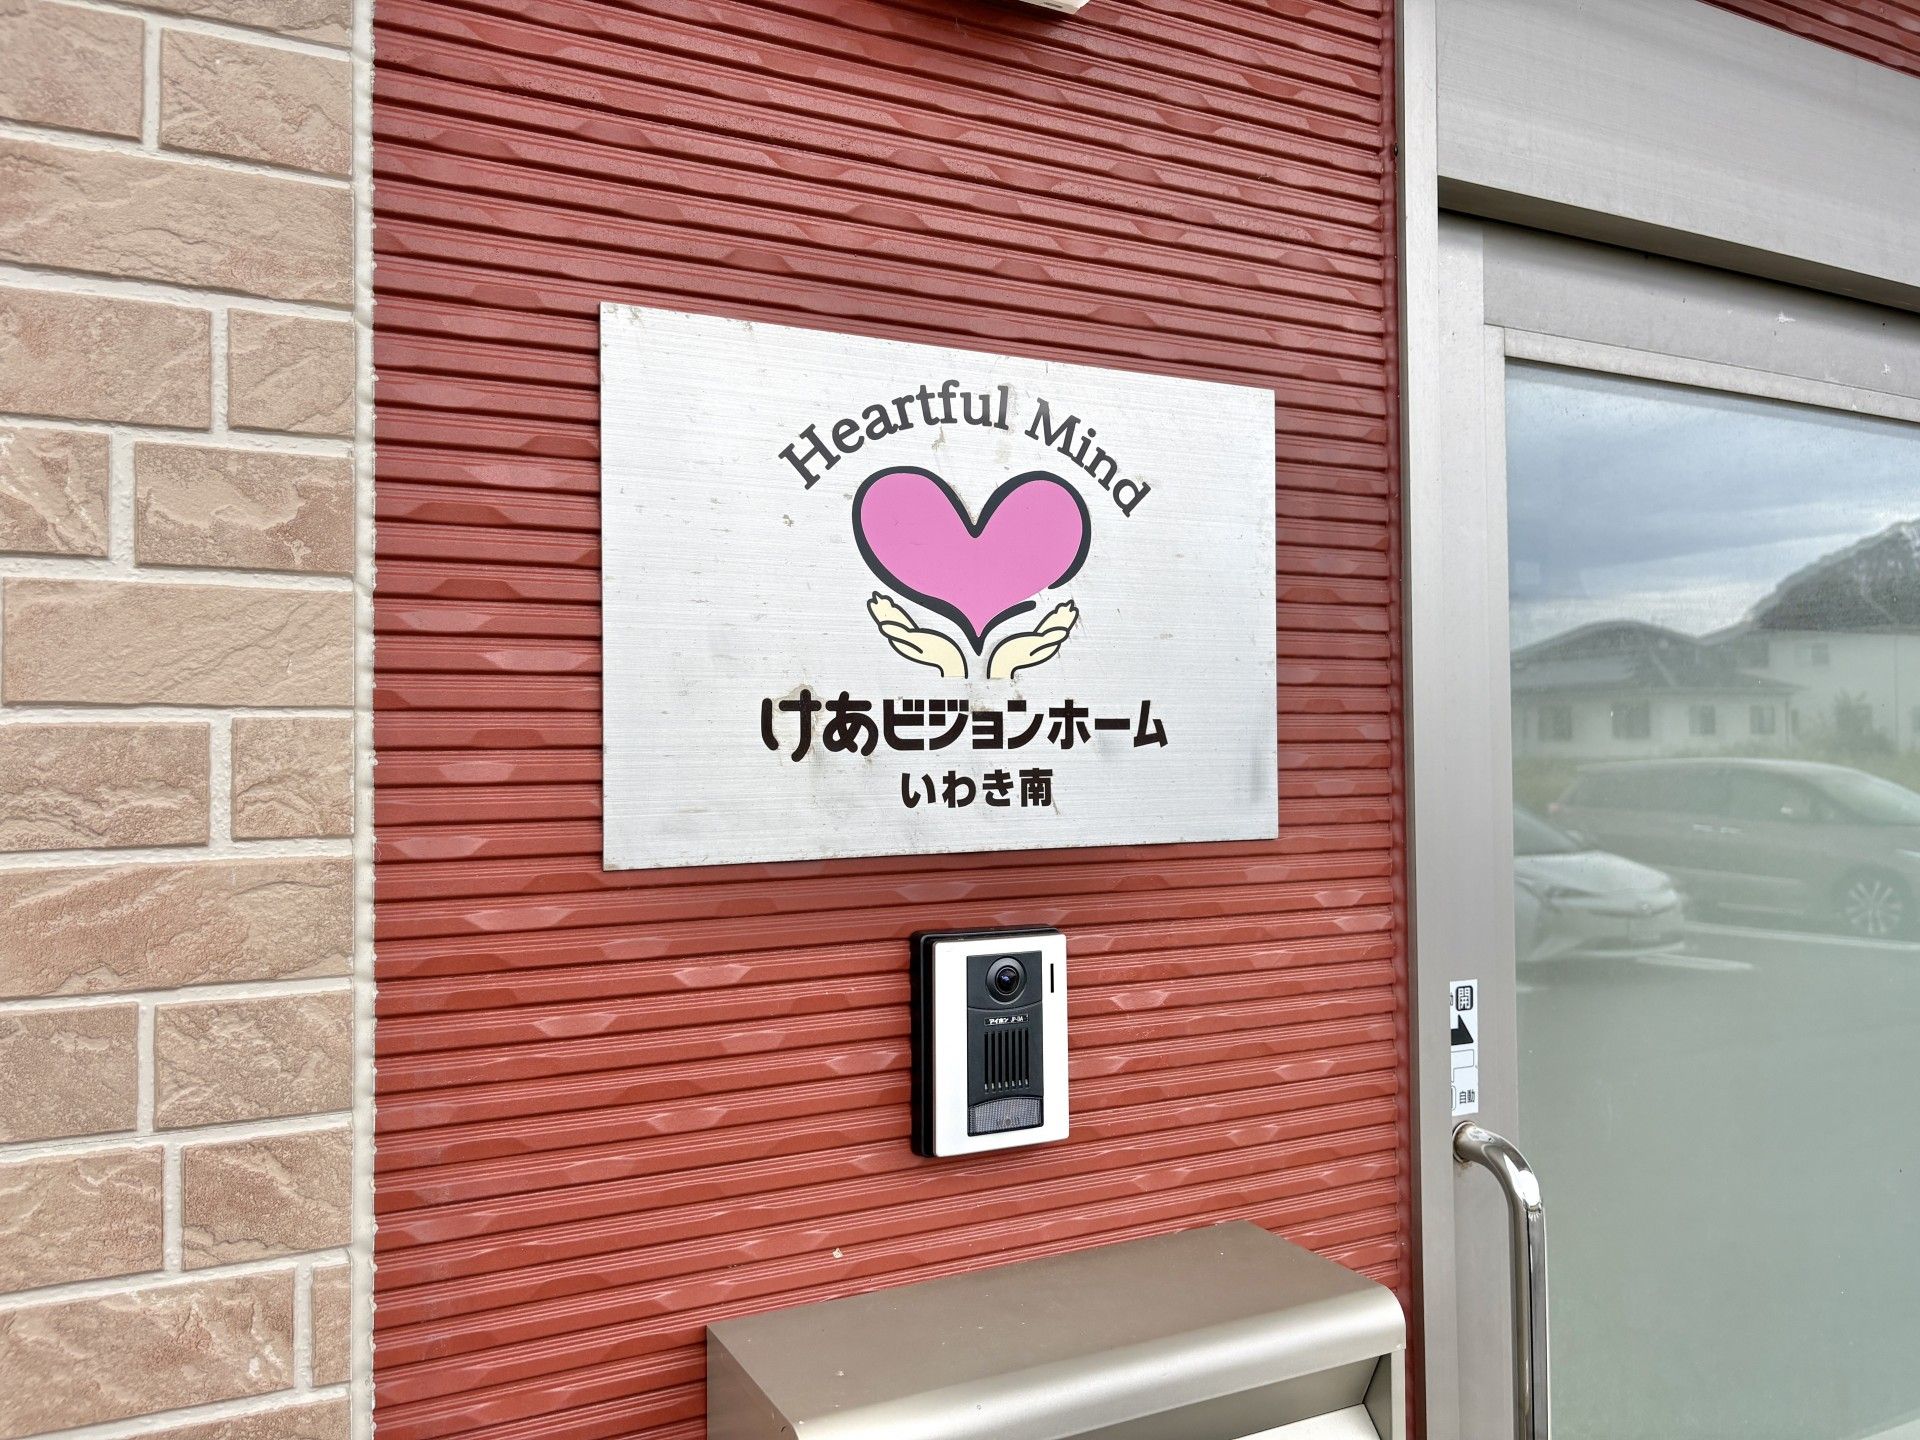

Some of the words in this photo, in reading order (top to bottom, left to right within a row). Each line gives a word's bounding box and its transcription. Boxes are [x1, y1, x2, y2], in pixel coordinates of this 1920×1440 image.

[779, 379, 1010, 490] Heartful
[1024, 397, 1152, 517] Mind
[760, 688, 1168, 762] けあビジョンホーム
[901, 767, 1053, 808] いわき南
[1456, 986, 1472, 1010] 開
[1459, 1089, 1475, 1104] 自動
